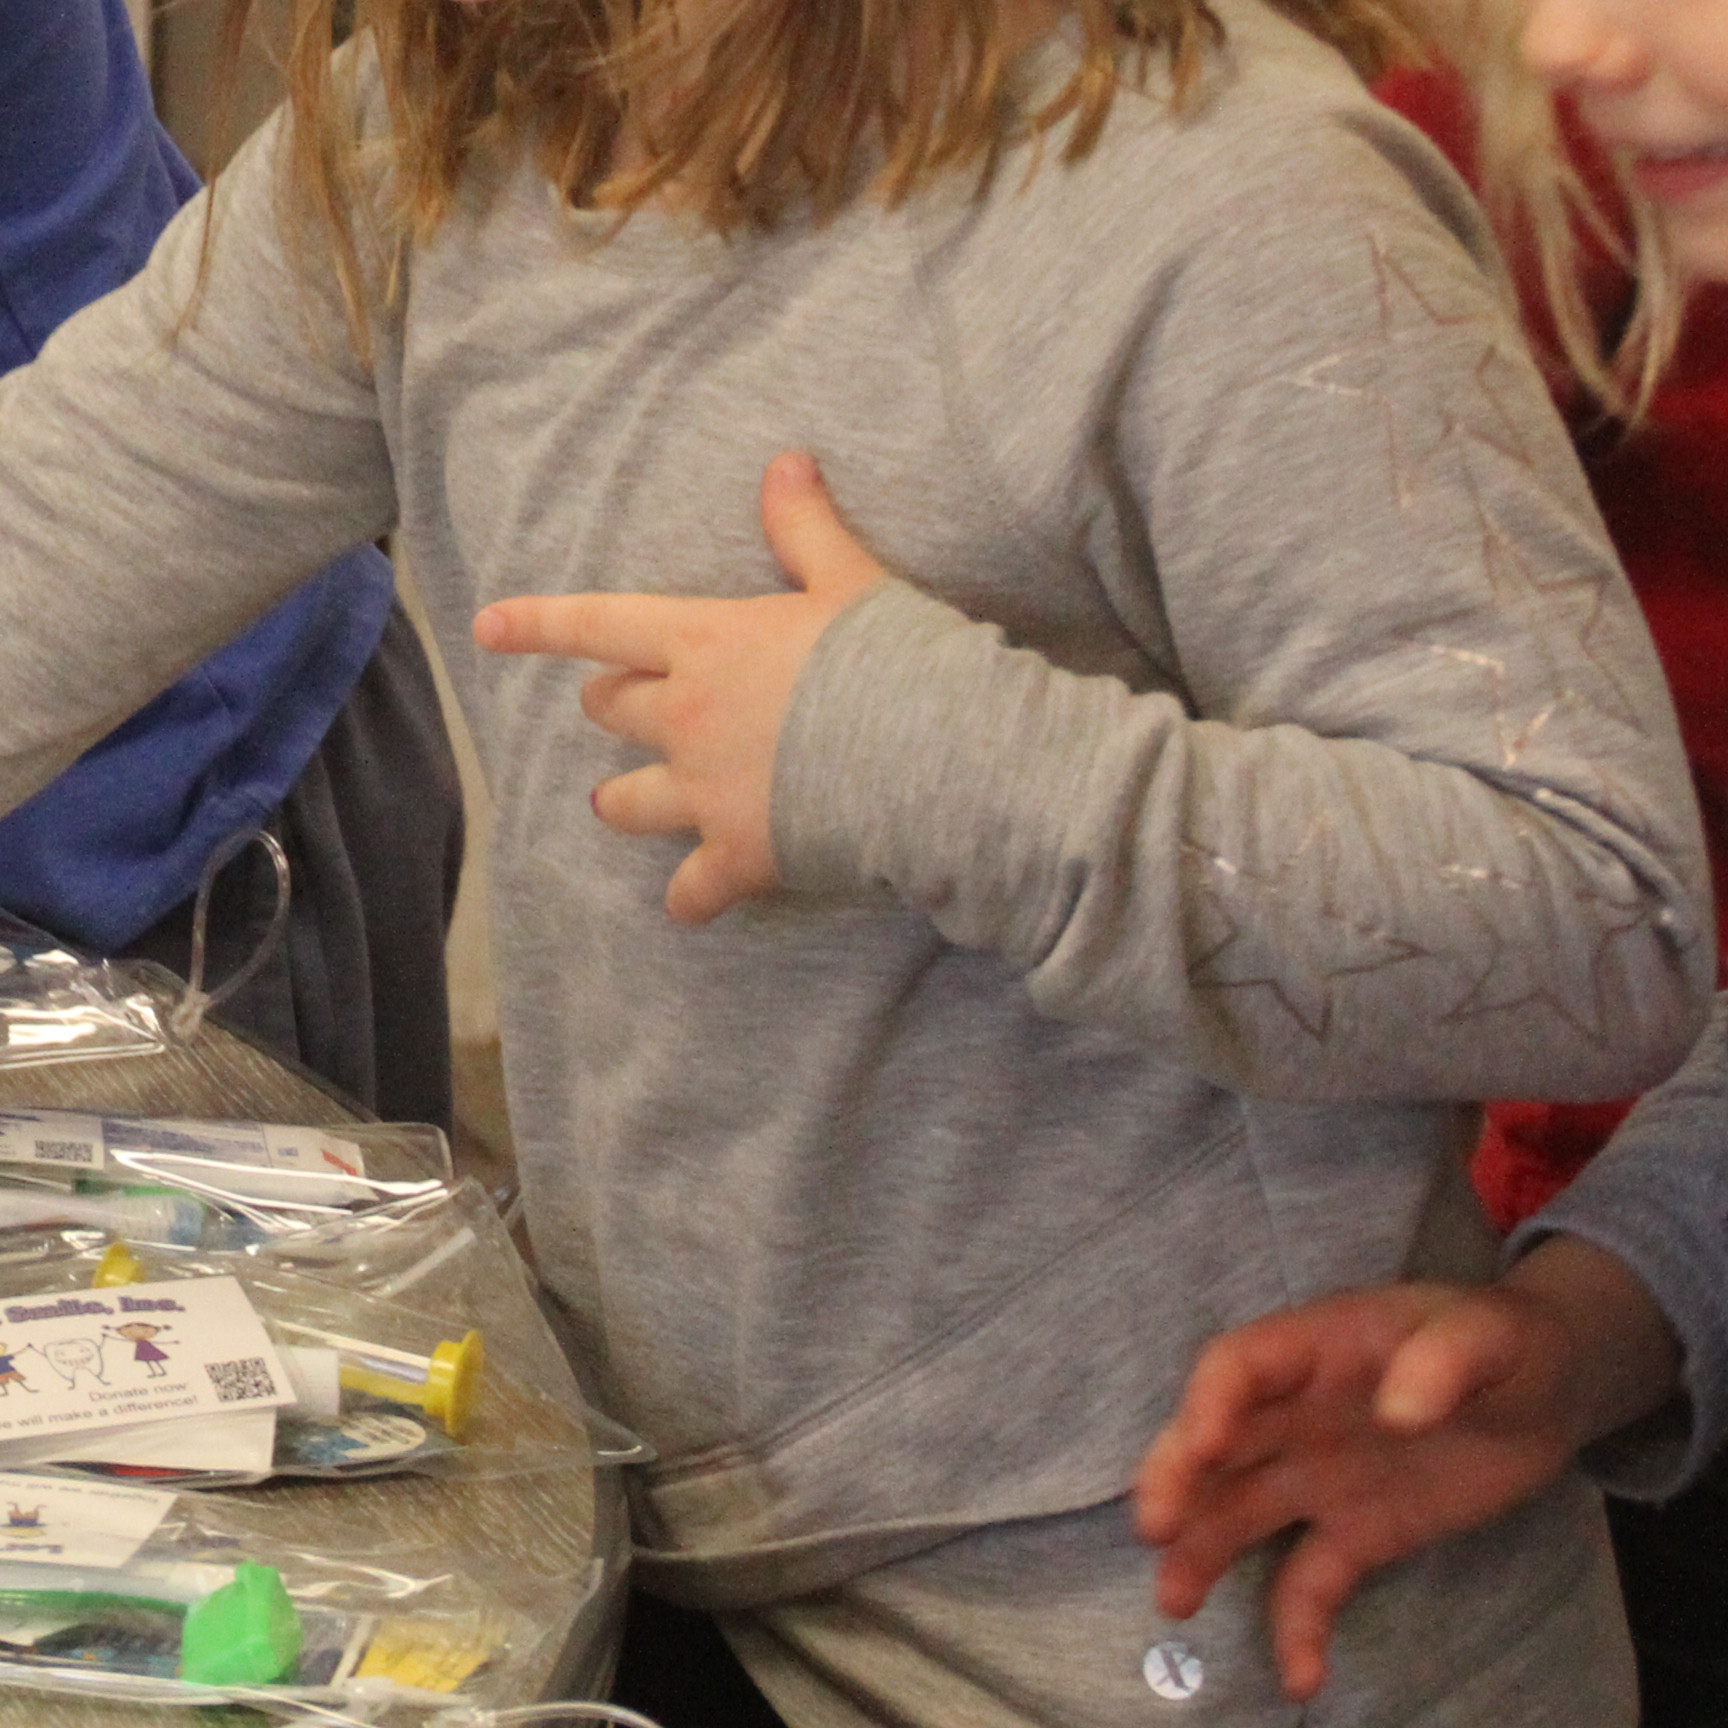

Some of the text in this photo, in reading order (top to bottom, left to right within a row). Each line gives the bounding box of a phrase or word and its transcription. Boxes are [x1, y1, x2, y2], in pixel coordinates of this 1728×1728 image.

[4, 1297, 115, 1325] Smile,
[117, 1294, 186, 1314] Inc.
[17, 1414, 43, 1427] will
[47, 1408, 94, 1423] make
[113, 1394, 199, 1415] difference!
[88, 1387, 149, 1403] Donate
